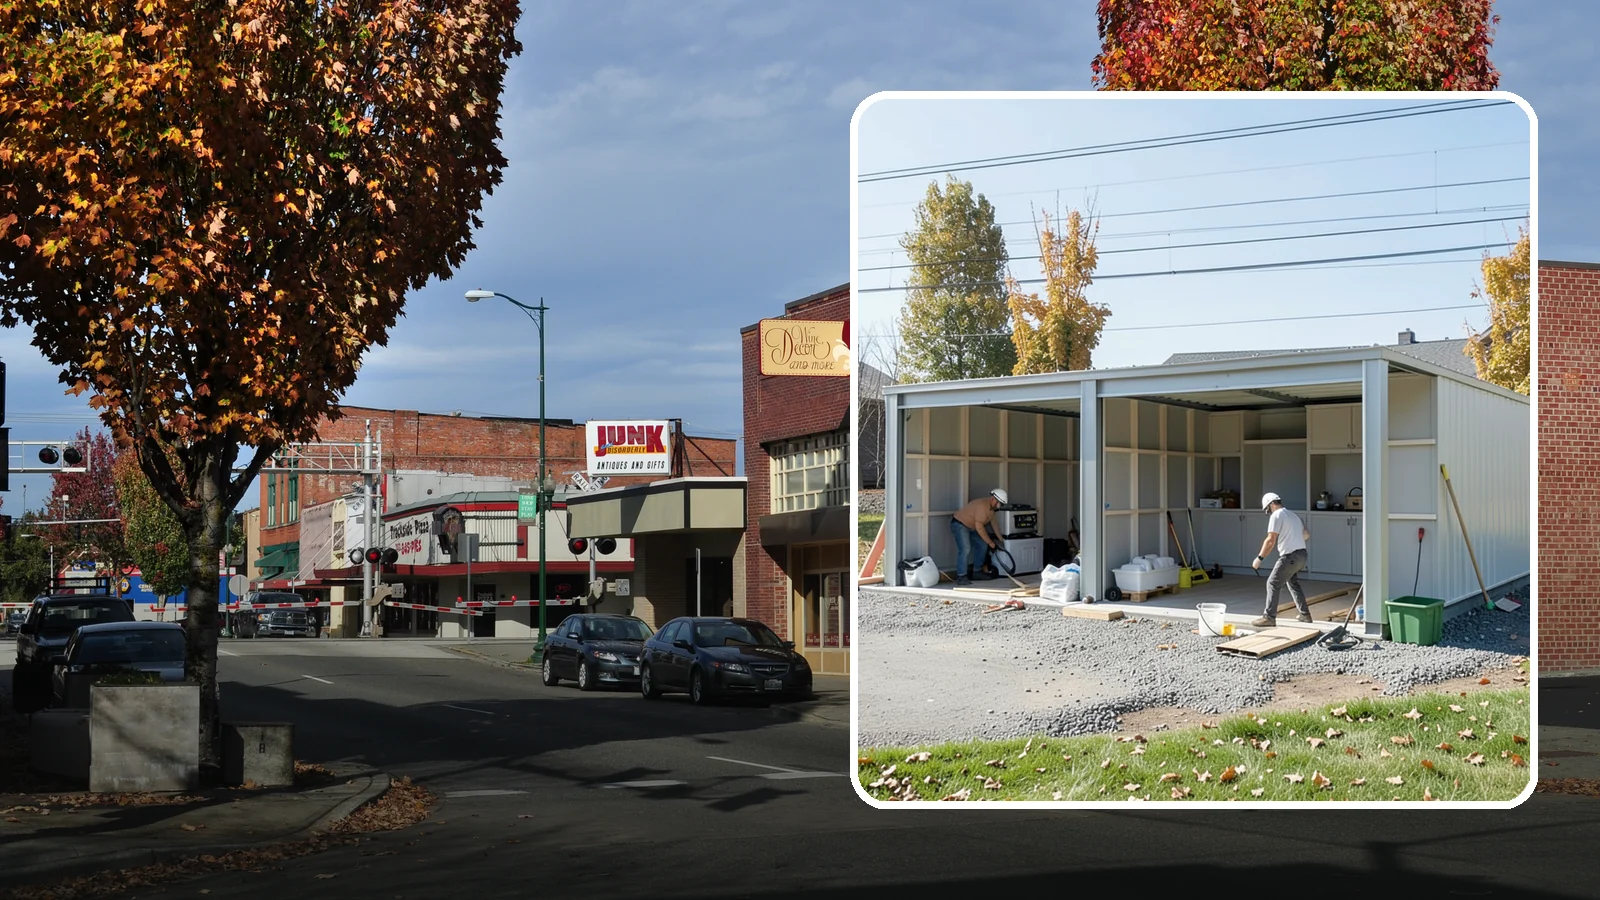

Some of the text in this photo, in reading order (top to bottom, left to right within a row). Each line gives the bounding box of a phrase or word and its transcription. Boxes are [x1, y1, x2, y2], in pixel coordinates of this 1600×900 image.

[765, 327, 831, 365] Decor
[595, 425, 665, 457] JUNK
[607, 446, 646, 454] DISORDERLY
[597, 460, 666, 470] ANTIQUES AND GIFTS
[390, 519, 429, 540] Trackside Pizza
